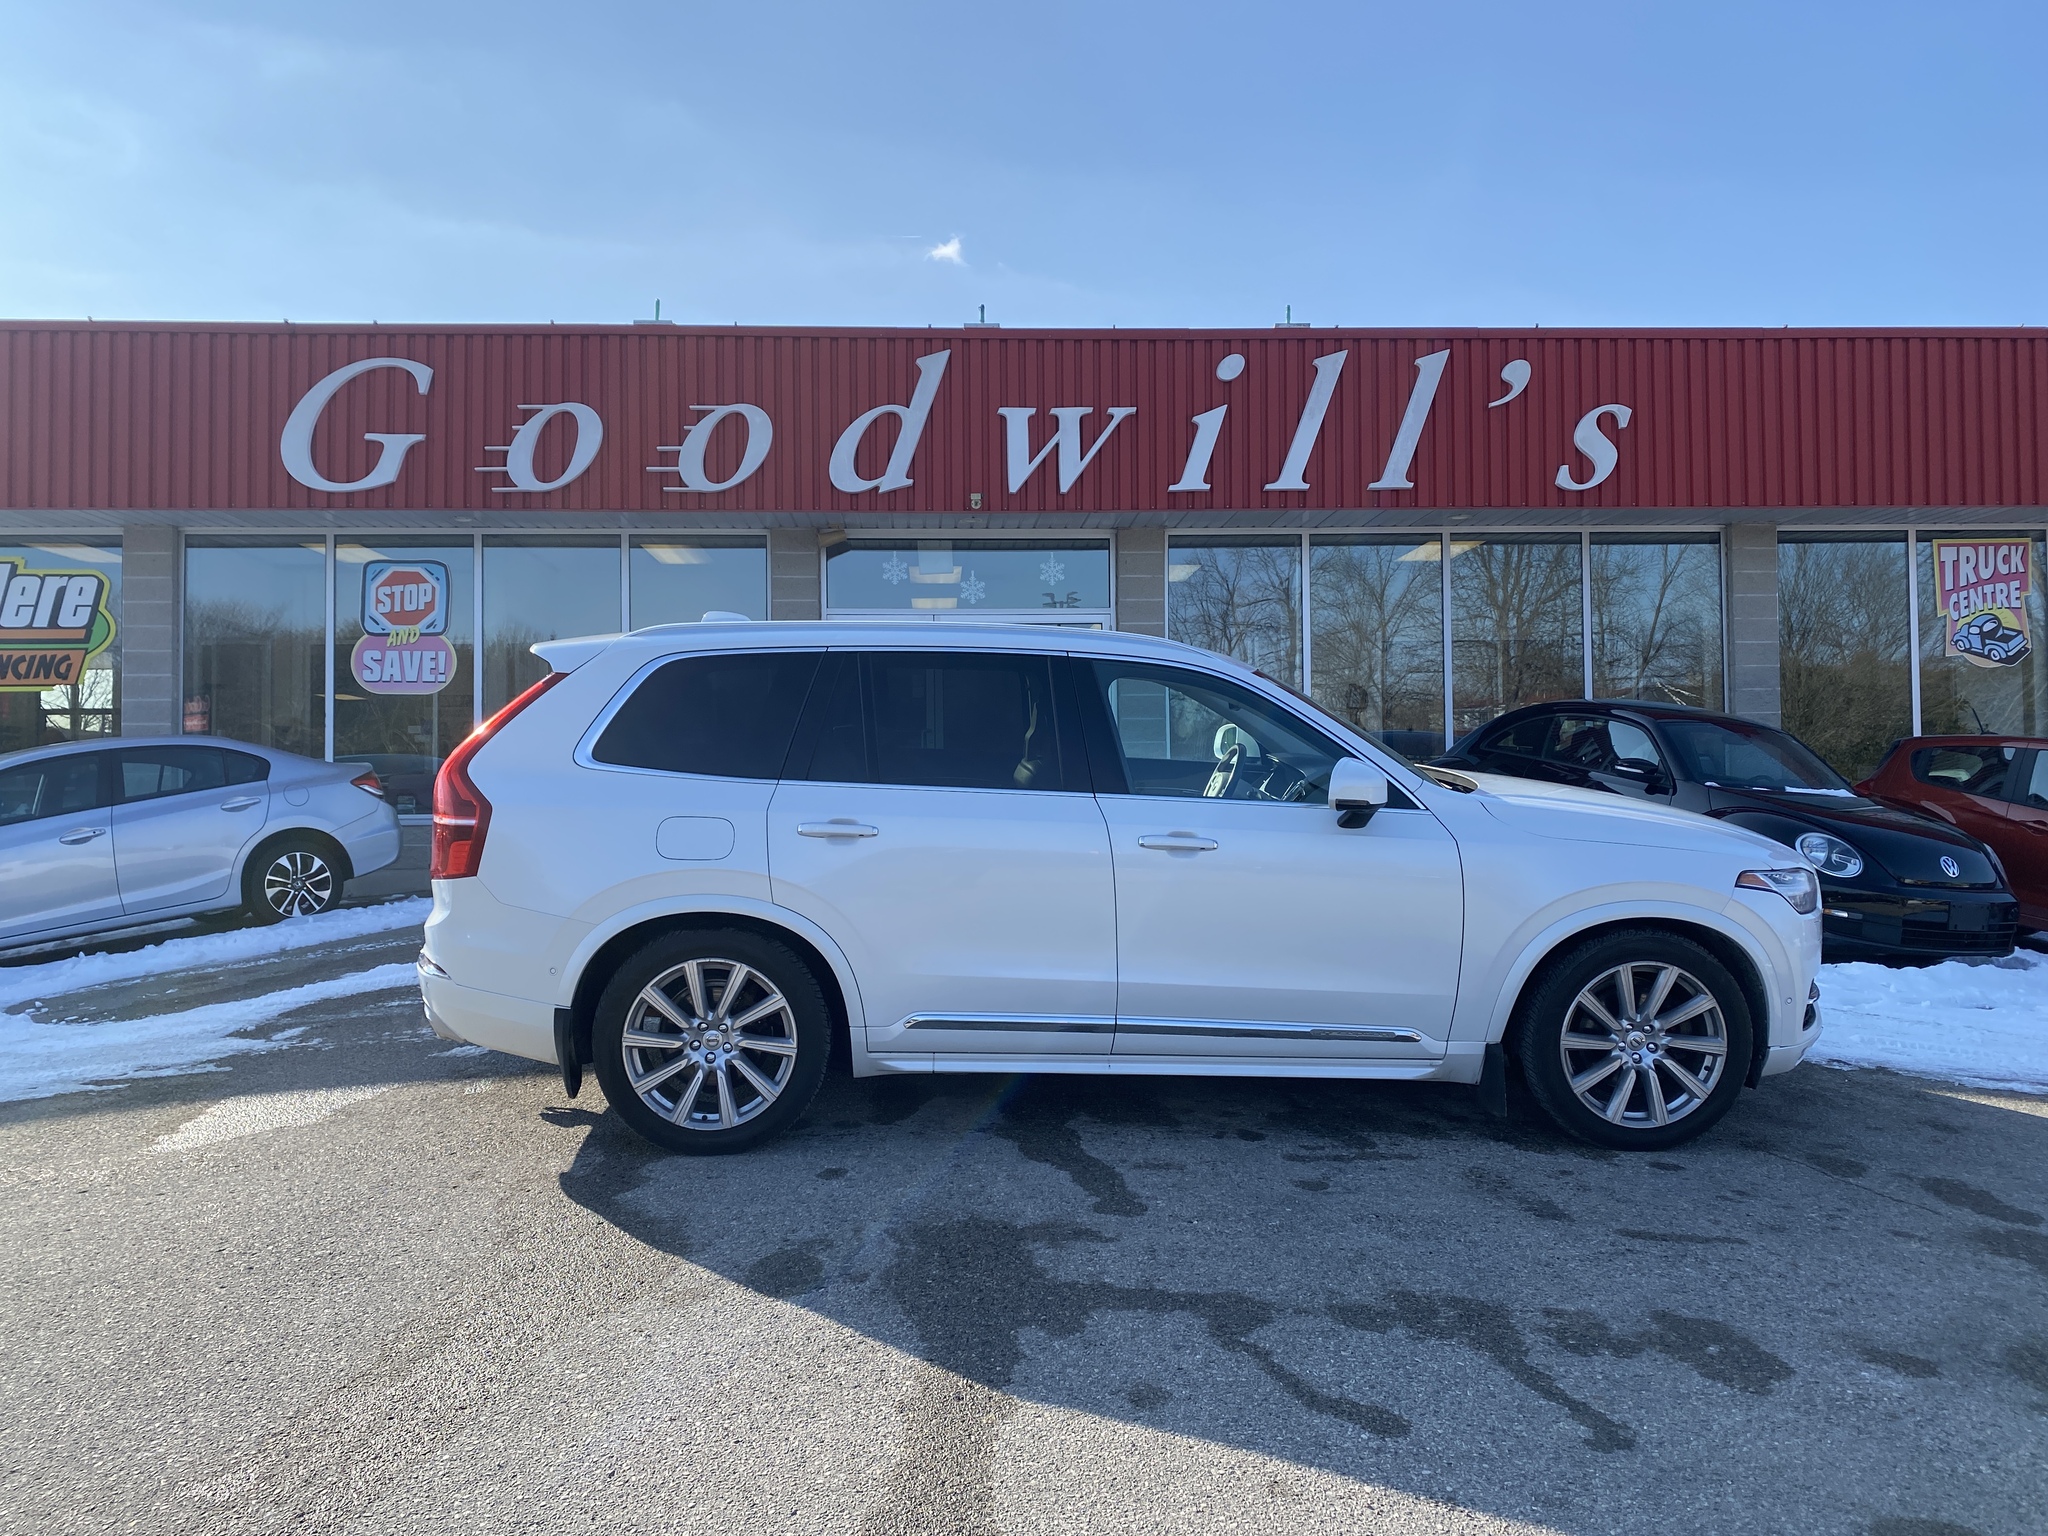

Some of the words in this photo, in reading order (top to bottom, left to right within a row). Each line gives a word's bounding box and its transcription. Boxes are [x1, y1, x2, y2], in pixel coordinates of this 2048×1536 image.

[280, 348, 1632, 494] Goodwill's
[1940, 545, 2025, 591] TRUCK
[377, 583, 433, 614] STOP
[1949, 580, 2022, 621] CENTRE
[386, 627, 421, 647] AND
[362, 650, 447, 683] SAVE!
